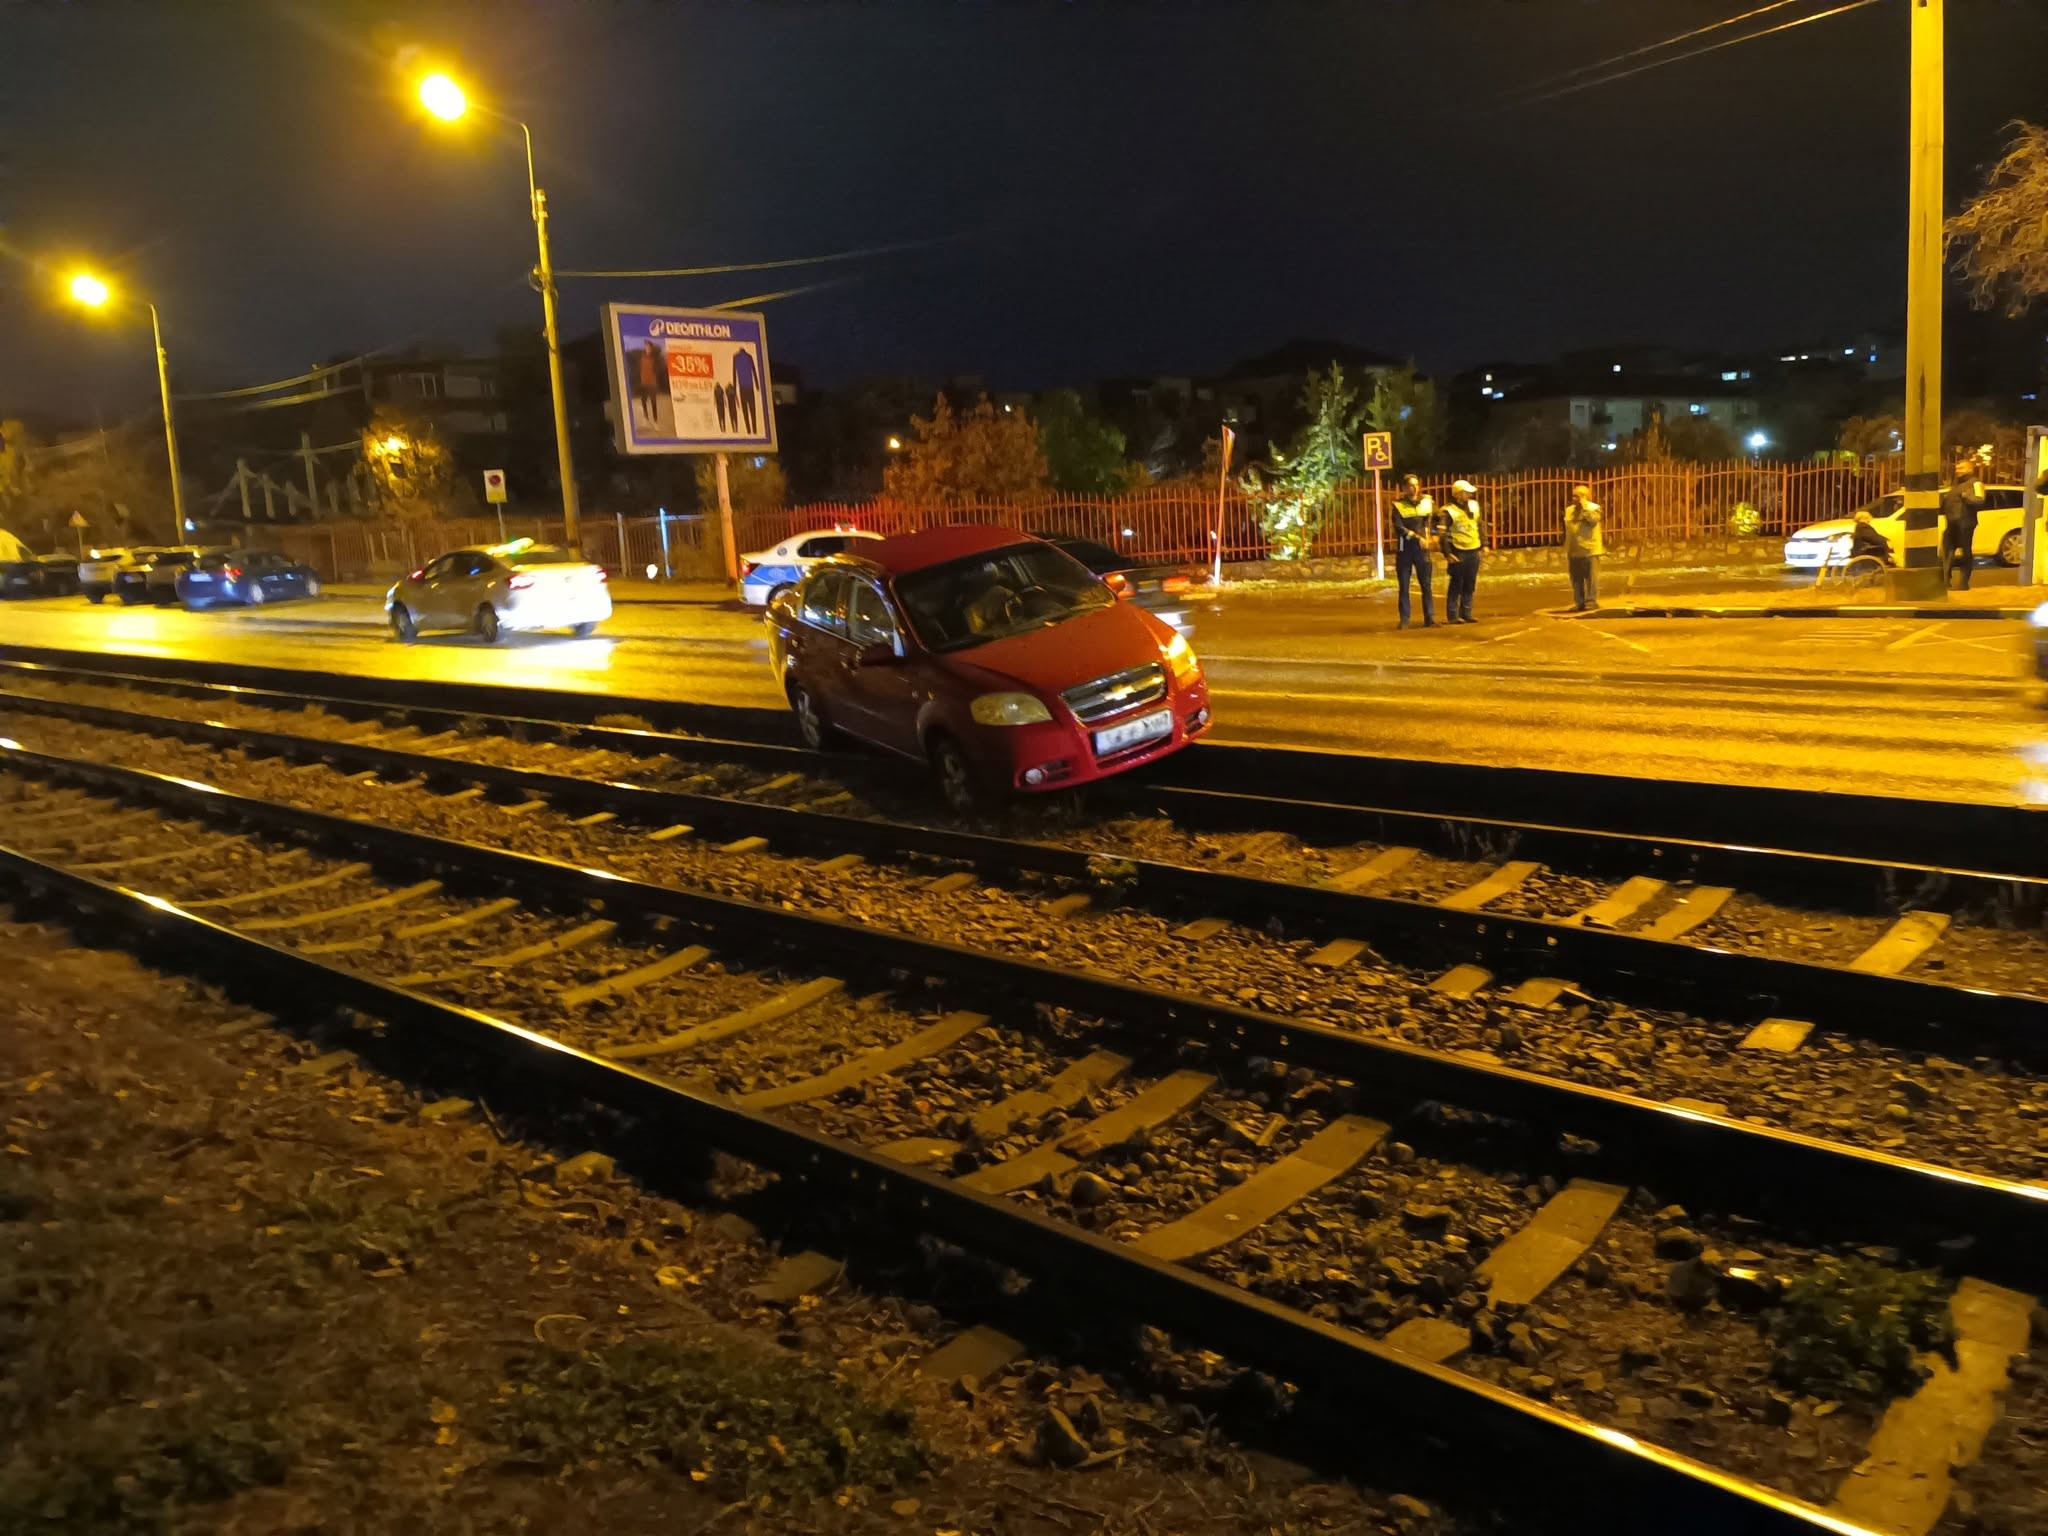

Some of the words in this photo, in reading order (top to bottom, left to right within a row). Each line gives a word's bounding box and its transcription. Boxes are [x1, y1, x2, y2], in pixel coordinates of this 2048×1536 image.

[666, 321, 731, 338] DECATHLON
[671, 355, 710, 374] -35%
[1367, 437, 1381, 455] P
